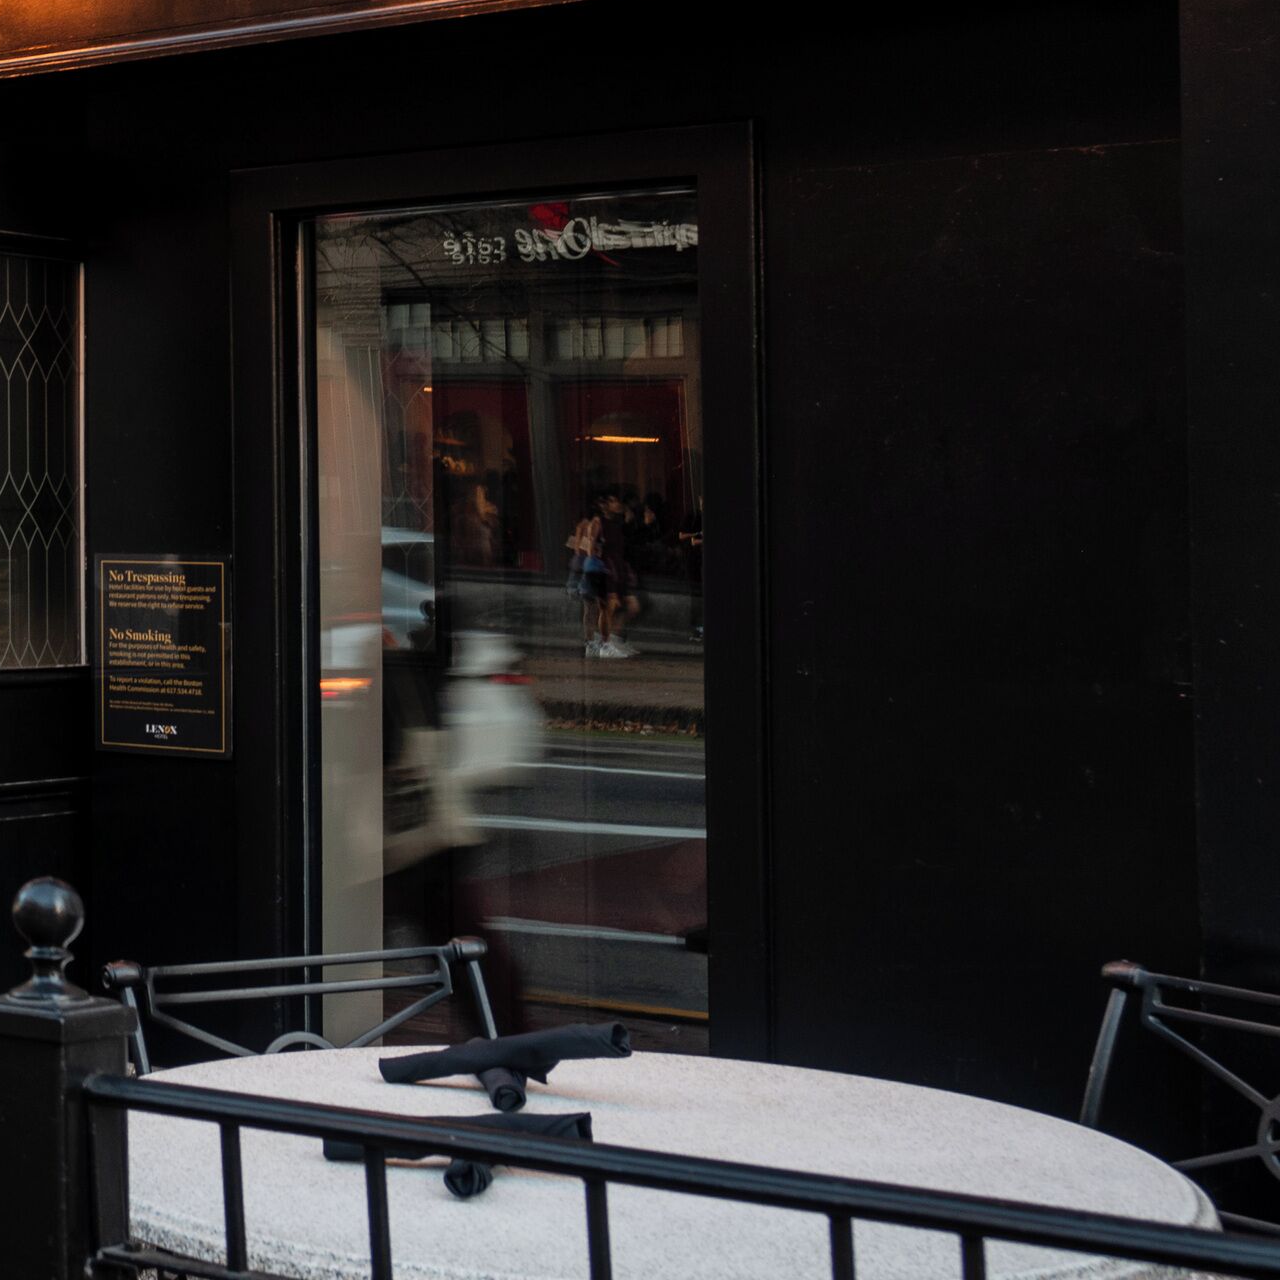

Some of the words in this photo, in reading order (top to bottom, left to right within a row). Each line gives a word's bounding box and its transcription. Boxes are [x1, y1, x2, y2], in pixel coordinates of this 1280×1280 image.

[109, 570, 124, 581] No
[125, 570, 186, 587] Trespassing
[110, 628, 124, 640] No
[125, 629, 172, 645] Smoking
